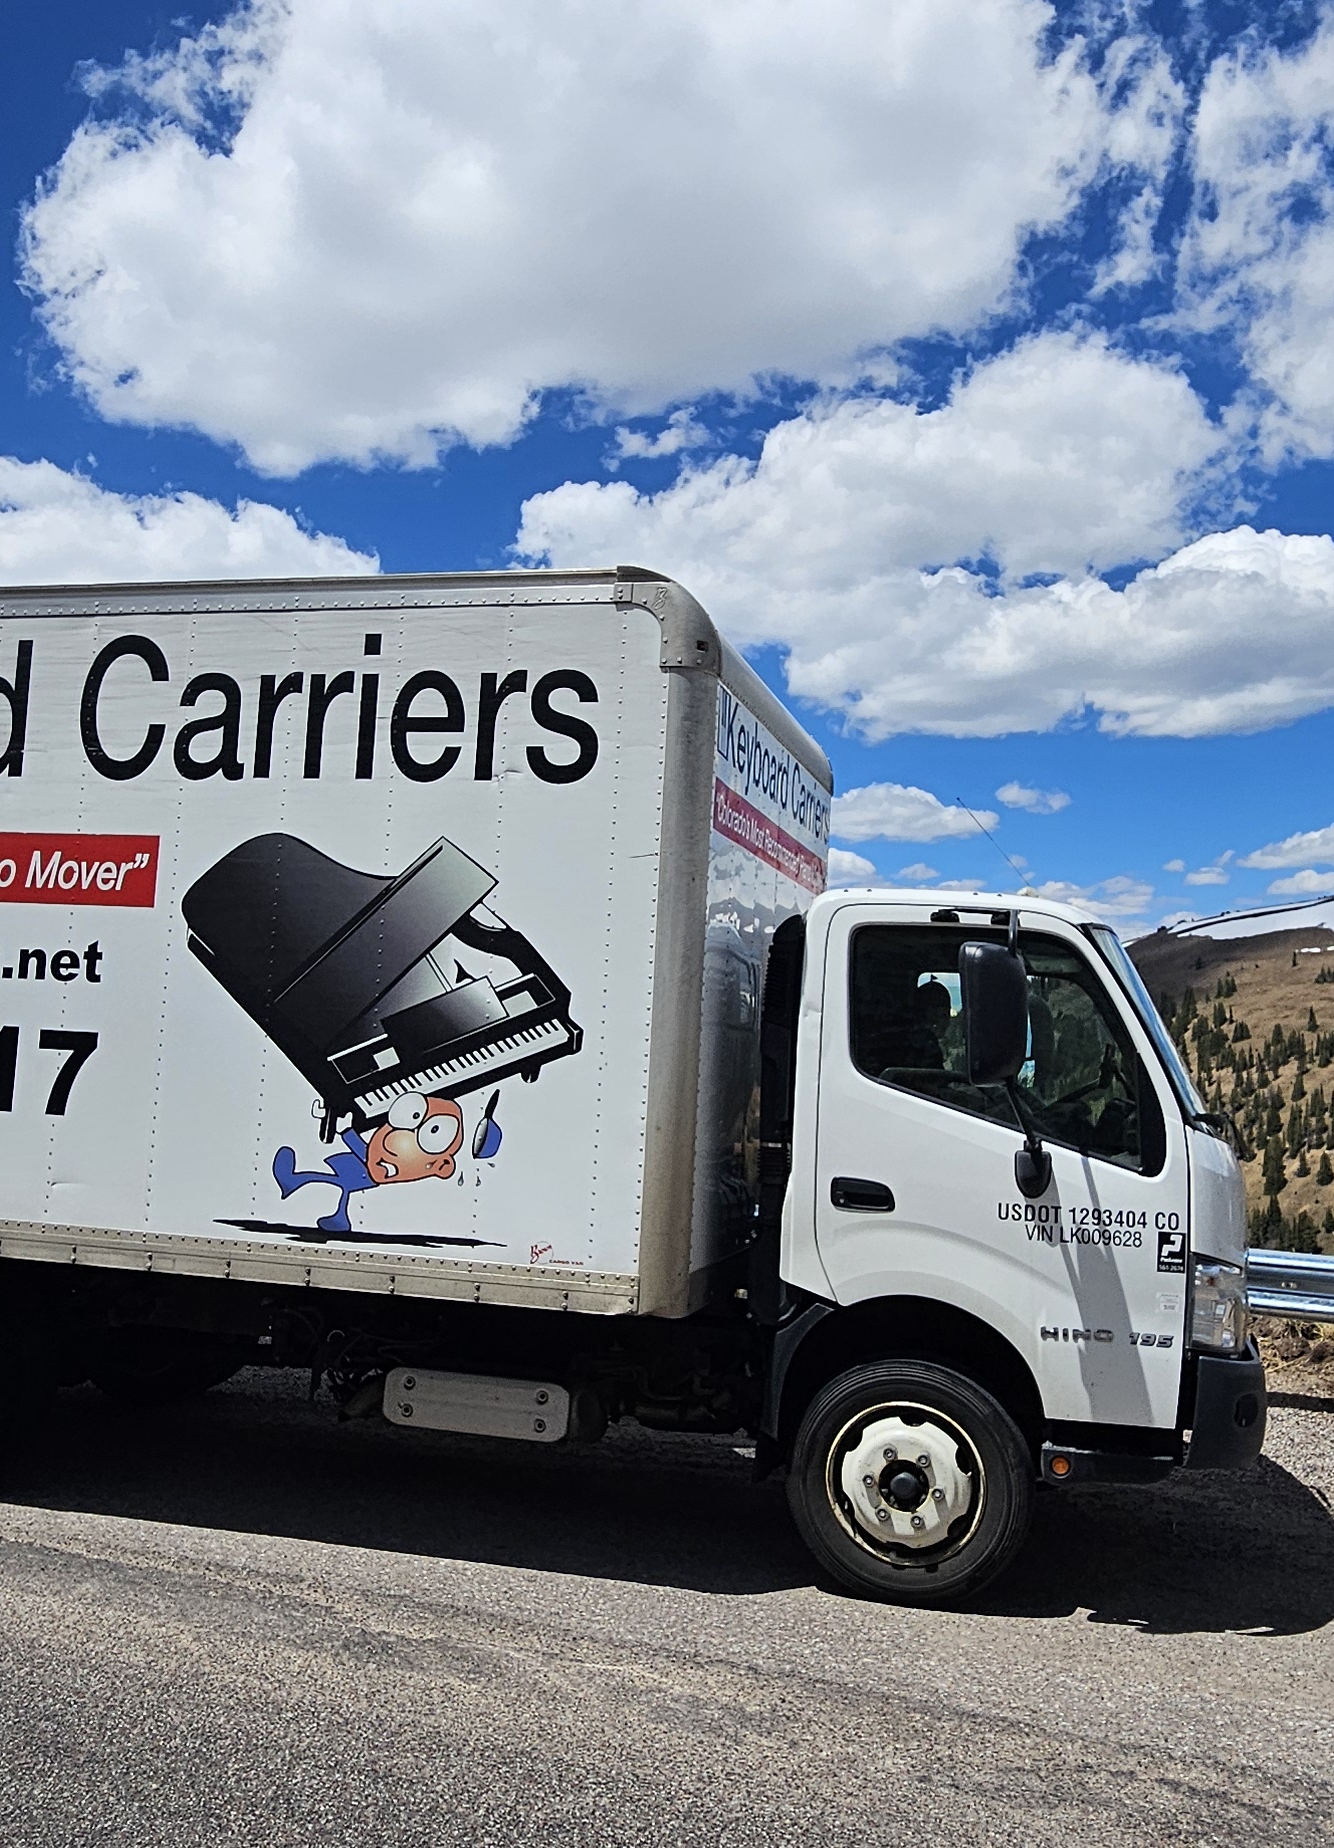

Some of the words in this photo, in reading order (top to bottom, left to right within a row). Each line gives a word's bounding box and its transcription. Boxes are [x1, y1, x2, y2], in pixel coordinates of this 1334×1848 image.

[80, 634, 598, 784] Carriers
[726, 695, 790, 809] Keyboard
[791, 762, 829, 845] Carriers
[997, 1202, 1062, 1224] USDOT
[1069, 1207, 1147, 1229] 1293404
[1154, 1211, 1180, 1231] CO
[1025, 1224, 1053, 1242] VIN
[1060, 1226, 1143, 1248] LK009628
[1040, 1325, 1114, 1344] HINO
[1129, 1332, 1174, 1349] 195
